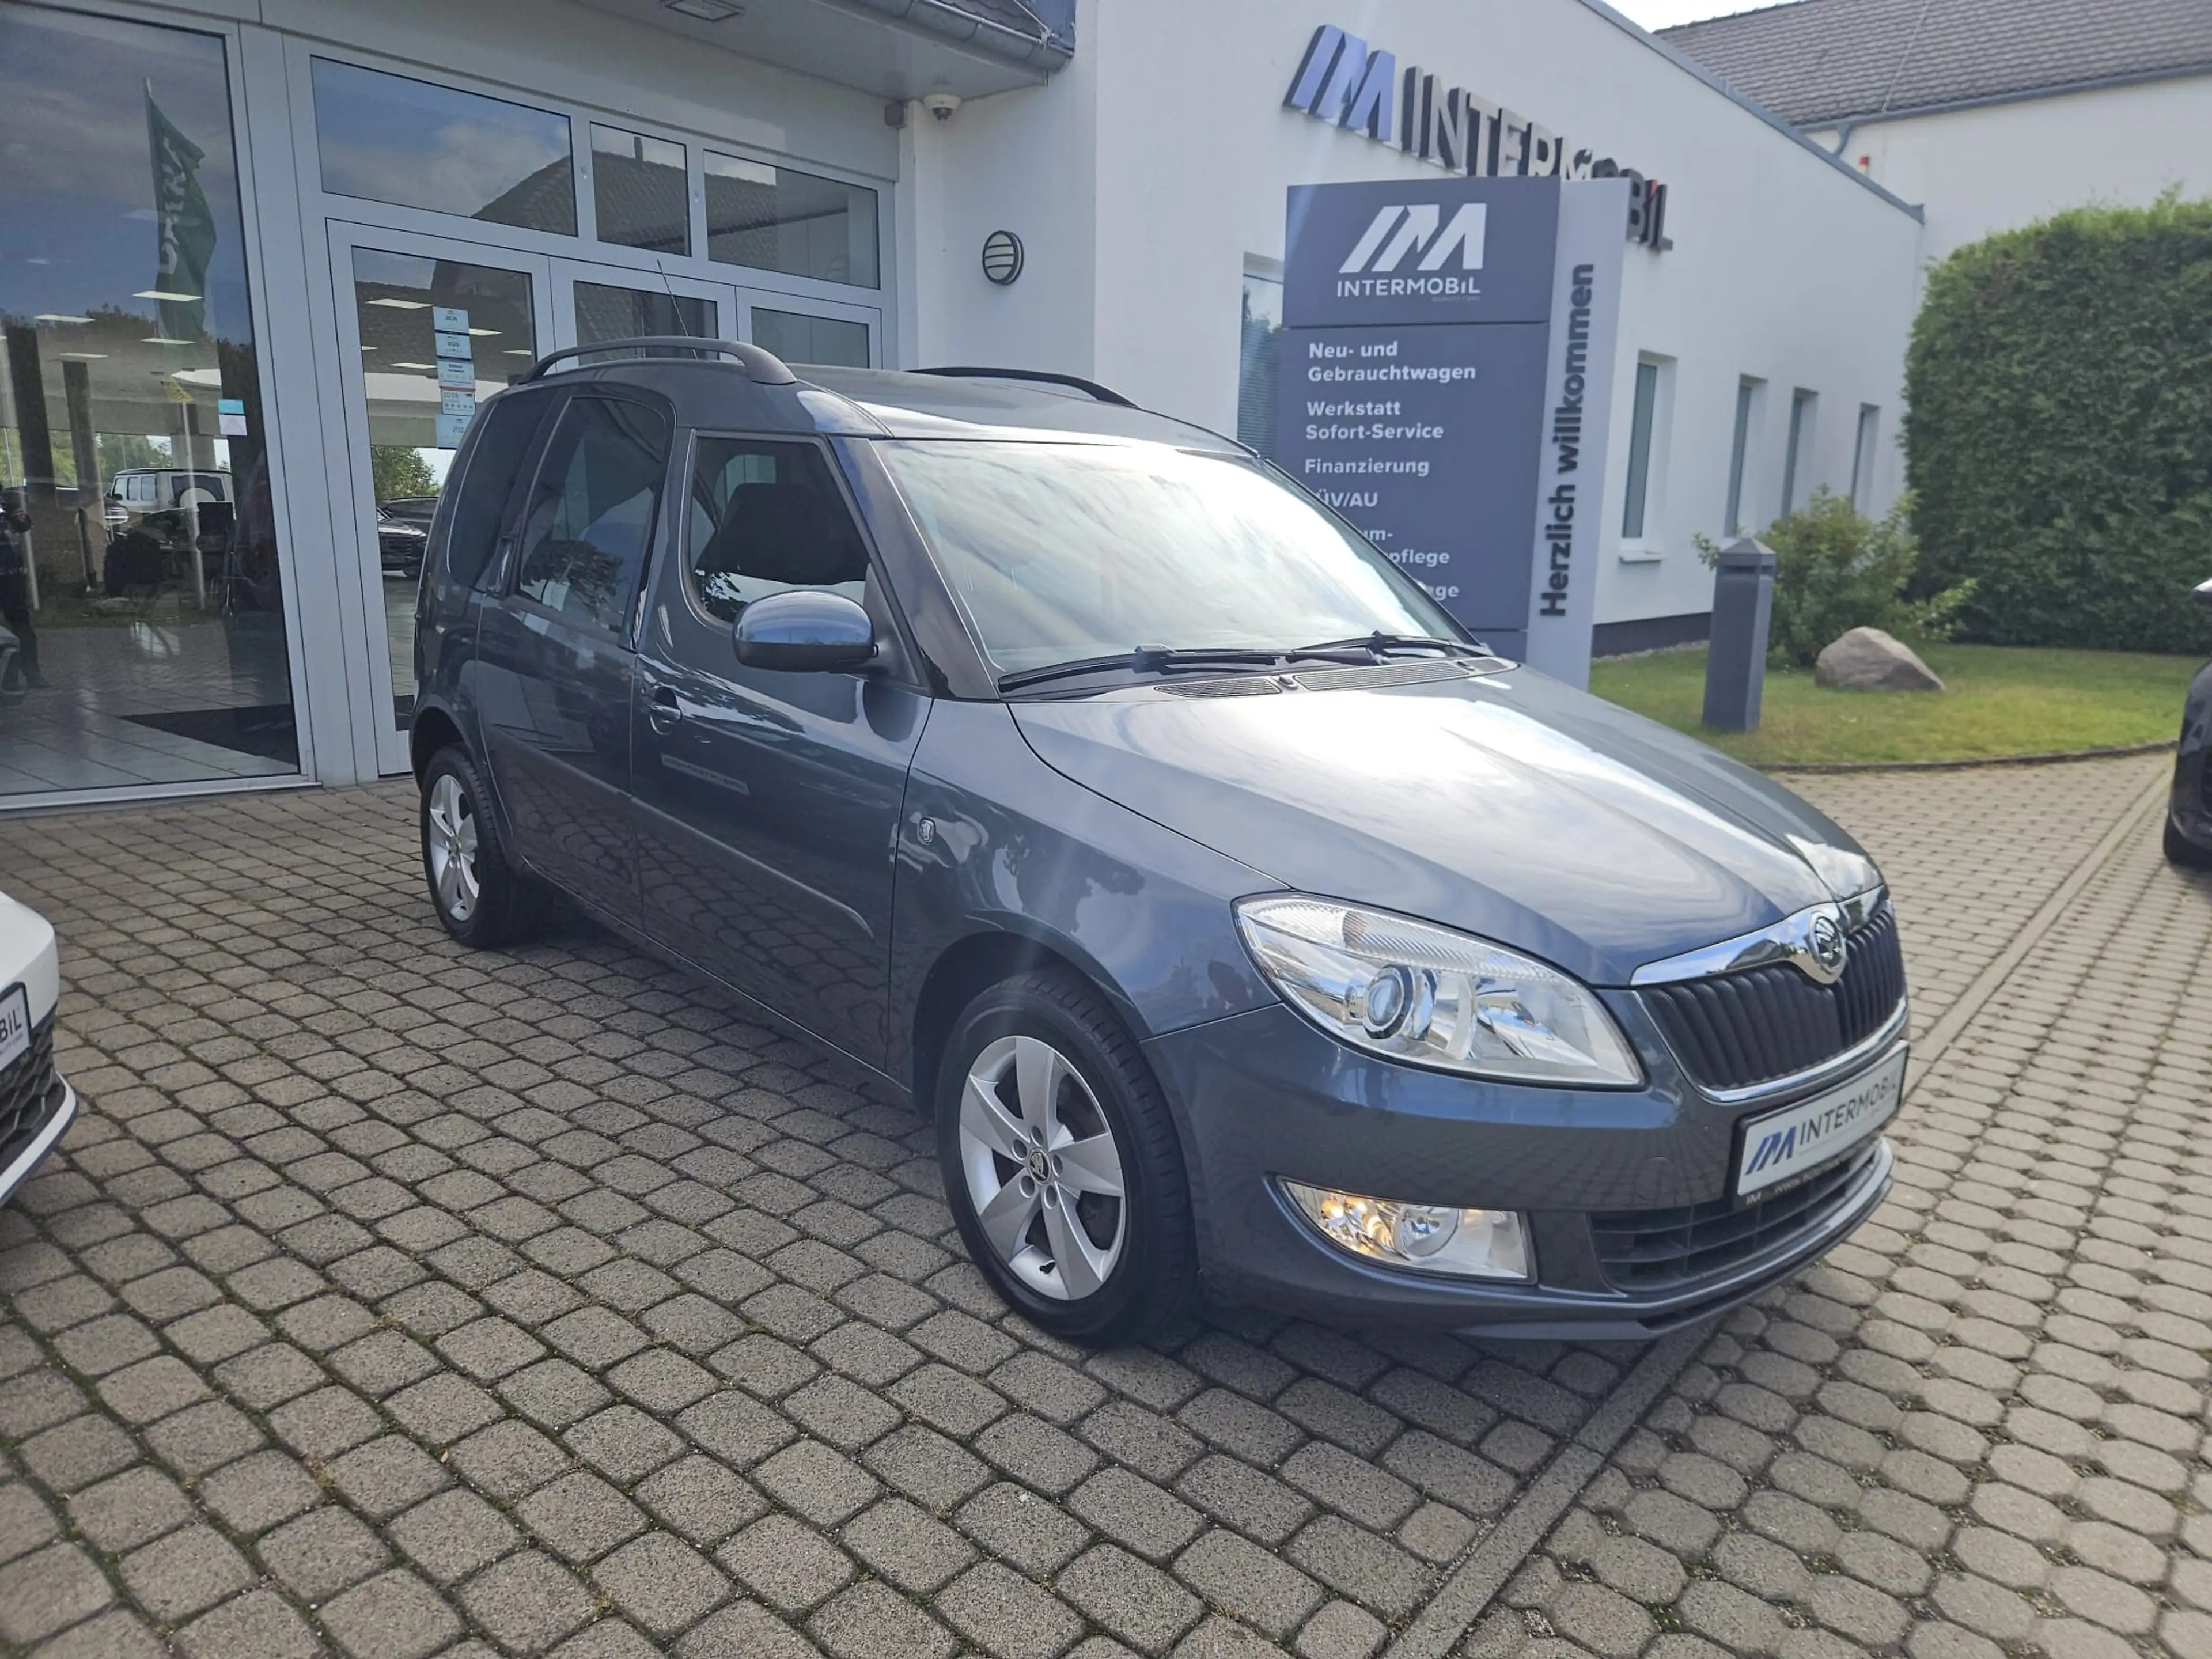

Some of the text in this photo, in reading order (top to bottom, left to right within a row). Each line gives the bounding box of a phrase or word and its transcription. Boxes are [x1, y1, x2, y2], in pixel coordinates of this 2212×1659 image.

[1309, 340, 1398, 358] Neu- und
[1308, 364, 1476, 384] Gebrauchtwagen
[1306, 400, 1401, 416] Werkstatt
[1305, 422, 1444, 440] Sofort-Service
[1539, 264, 1594, 617] Herzlich willkommen
[1304, 457, 1430, 477] Finanzierung
[1316, 489, 1378, 507] ÜV/AU
